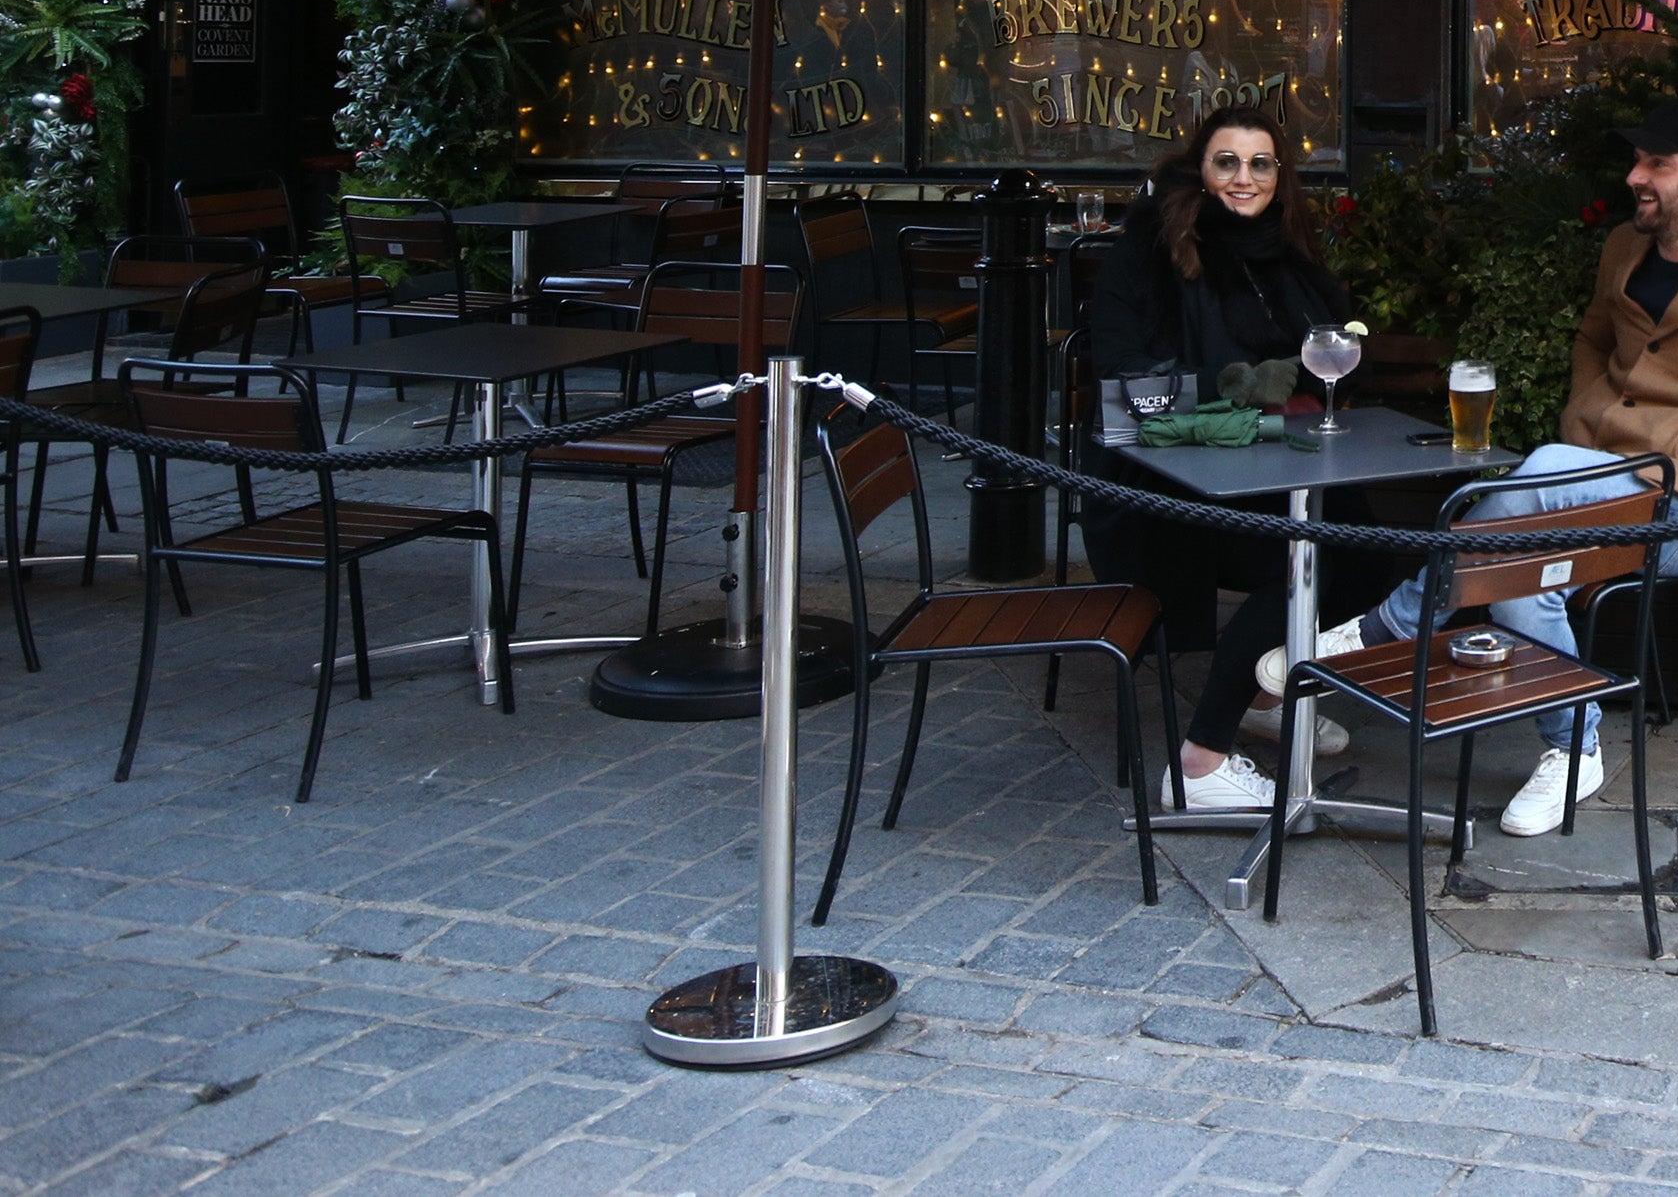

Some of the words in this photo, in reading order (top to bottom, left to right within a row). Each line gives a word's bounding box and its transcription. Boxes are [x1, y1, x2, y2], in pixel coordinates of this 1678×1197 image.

[199, 5, 252, 23] HEAD
[198, 29, 252, 42] COVENT
[197, 43, 252, 57] GARDEN
[617, 81, 650, 130] &
[656, 71, 751, 135] SON
[785, 77, 866, 138] LTD
[1032, 73, 1178, 141] SINCE
[1131, 395, 1174, 408] PACEN
